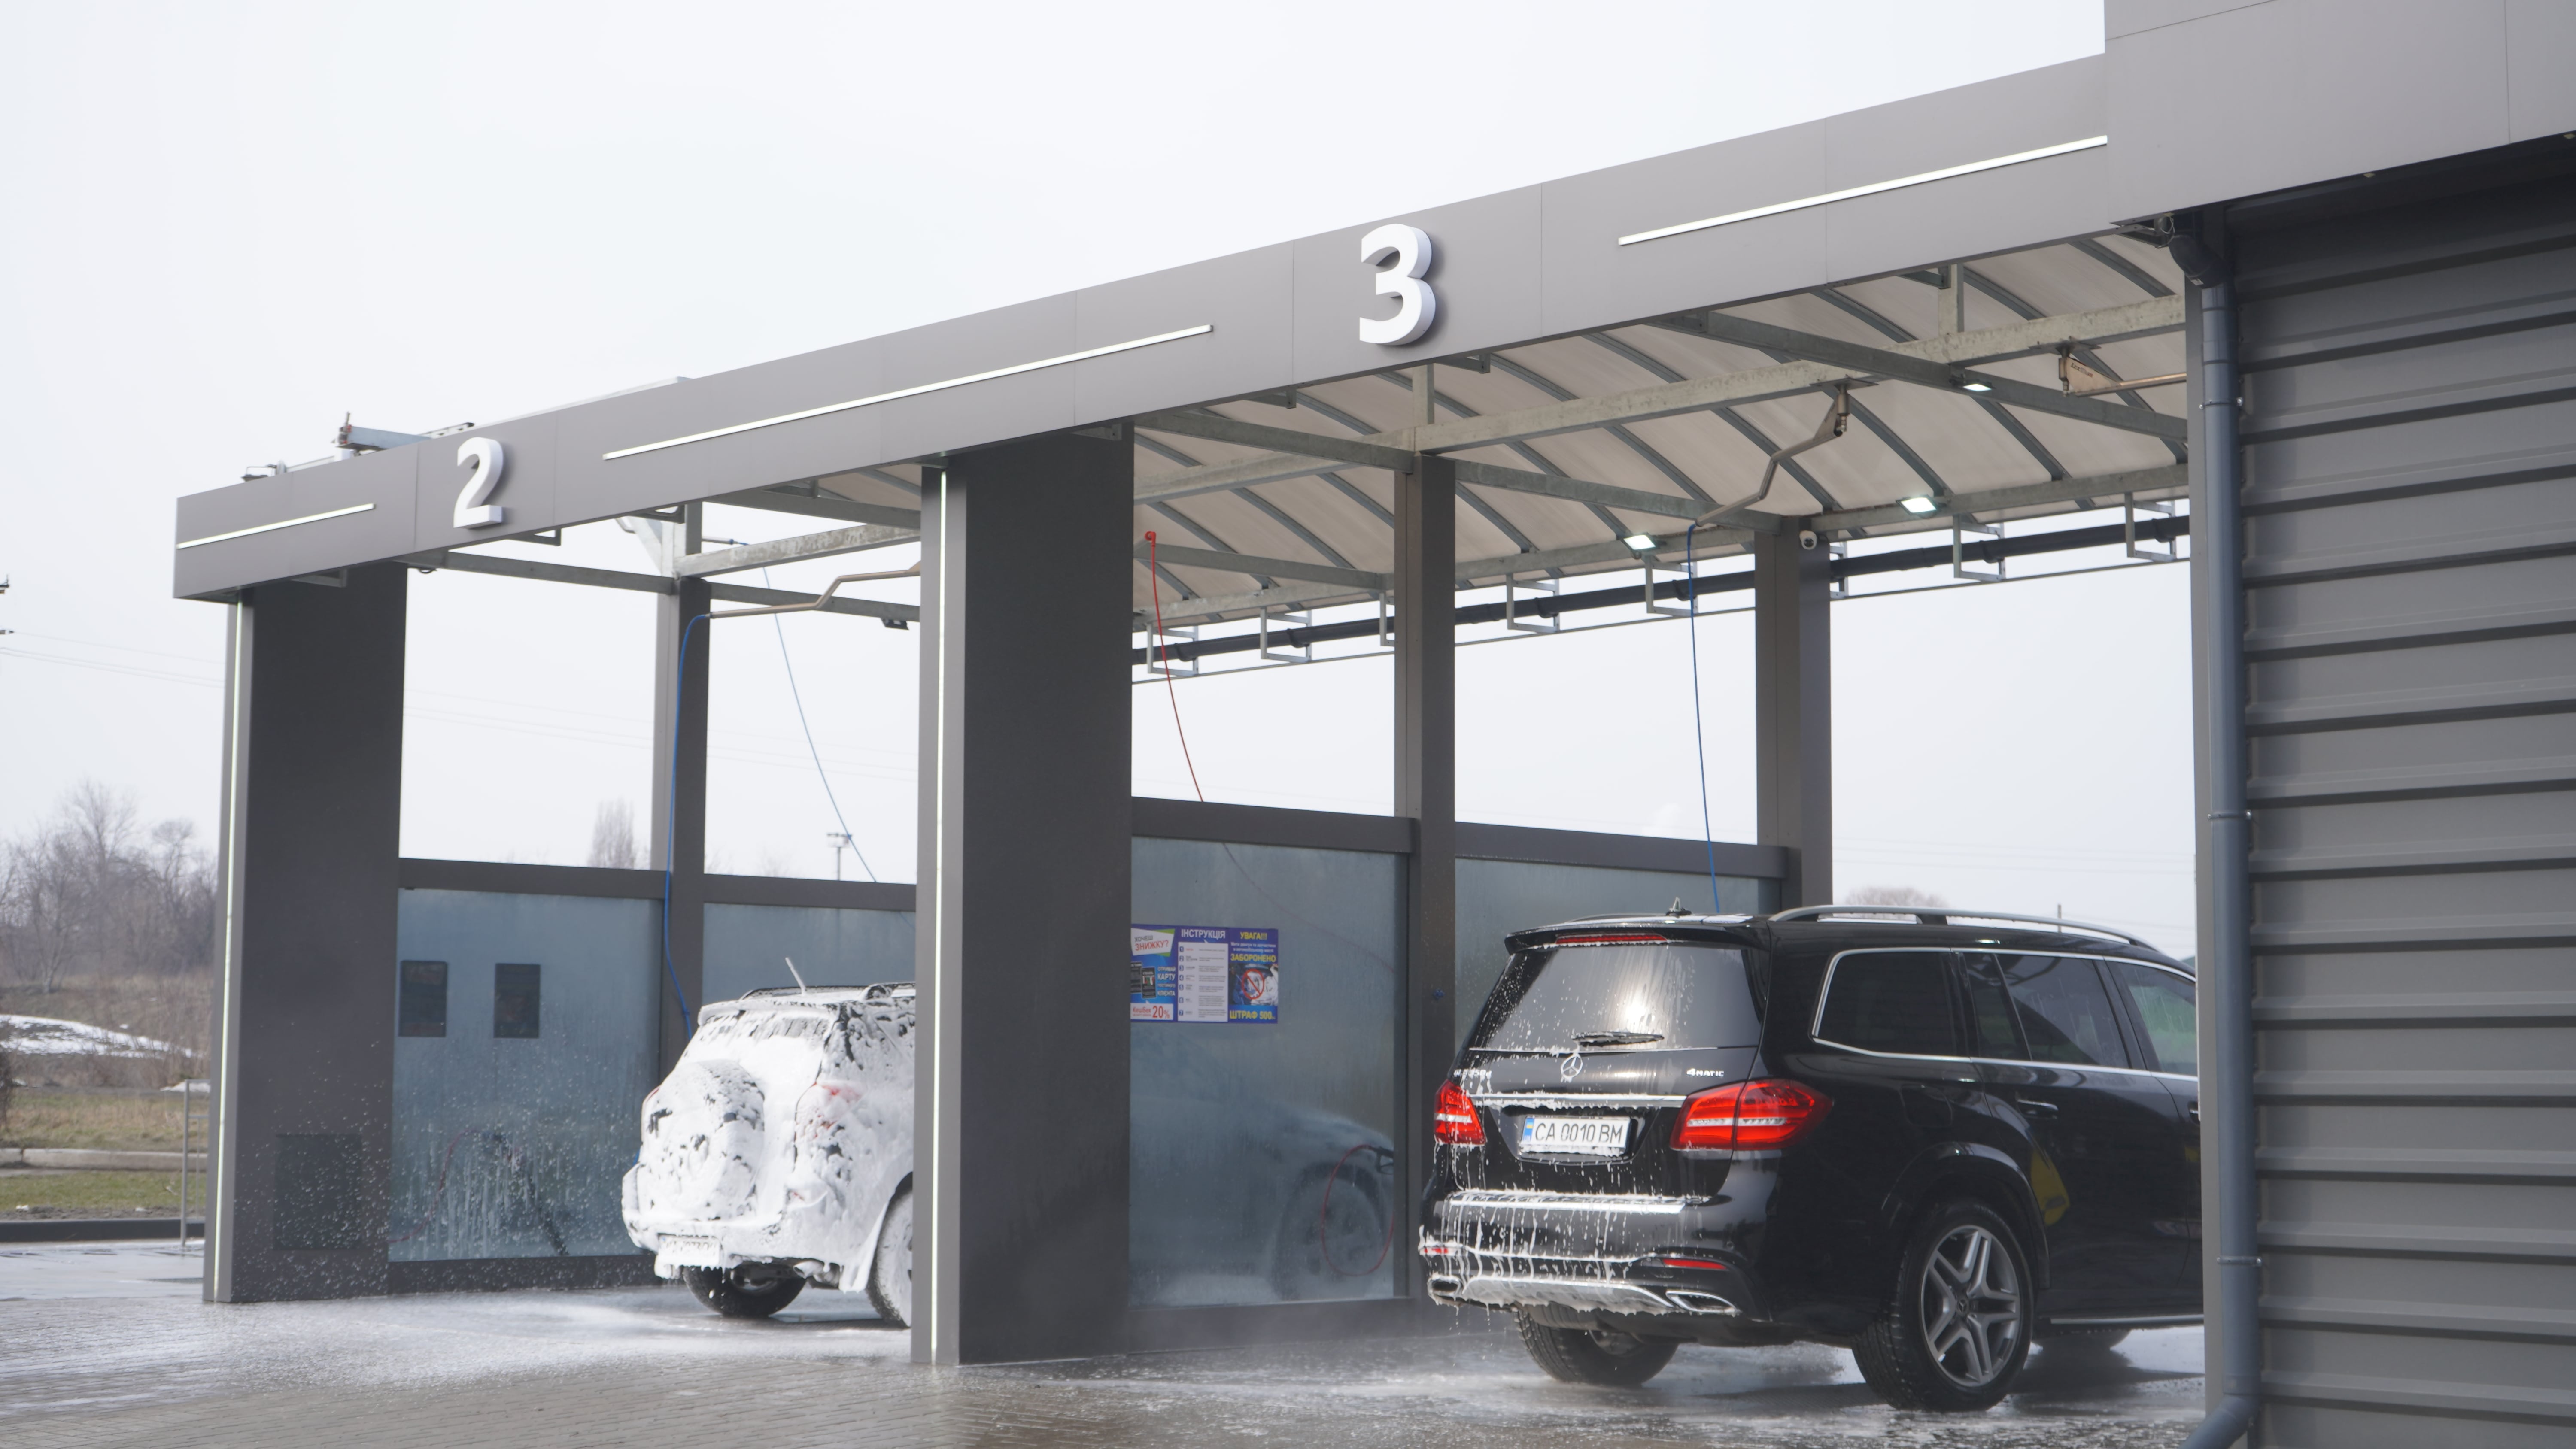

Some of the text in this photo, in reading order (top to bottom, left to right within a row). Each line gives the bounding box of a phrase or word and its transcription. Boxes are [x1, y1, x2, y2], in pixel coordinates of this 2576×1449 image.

[1359, 223, 1436, 346] 3
[453, 437, 504, 530] 2
[1181, 929, 1226, 940] ІНСТРУКЦІЯ
[1240, 932, 1267, 940] УВАГА!!!
[1135, 940, 1169, 951] ЗНИЖКУ?
[1230, 953, 1276, 962] ЗАБОРОНЕНО
[1157, 973, 1176, 981] КАРТУ
[1152, 1006, 1170, 1019] 20%
[1230, 1010, 1258, 1019] ШТРАФ
[1686, 1067, 1725, 1077] 4MATIC
[1535, 1123, 1623, 1144] CA 0010 BM
